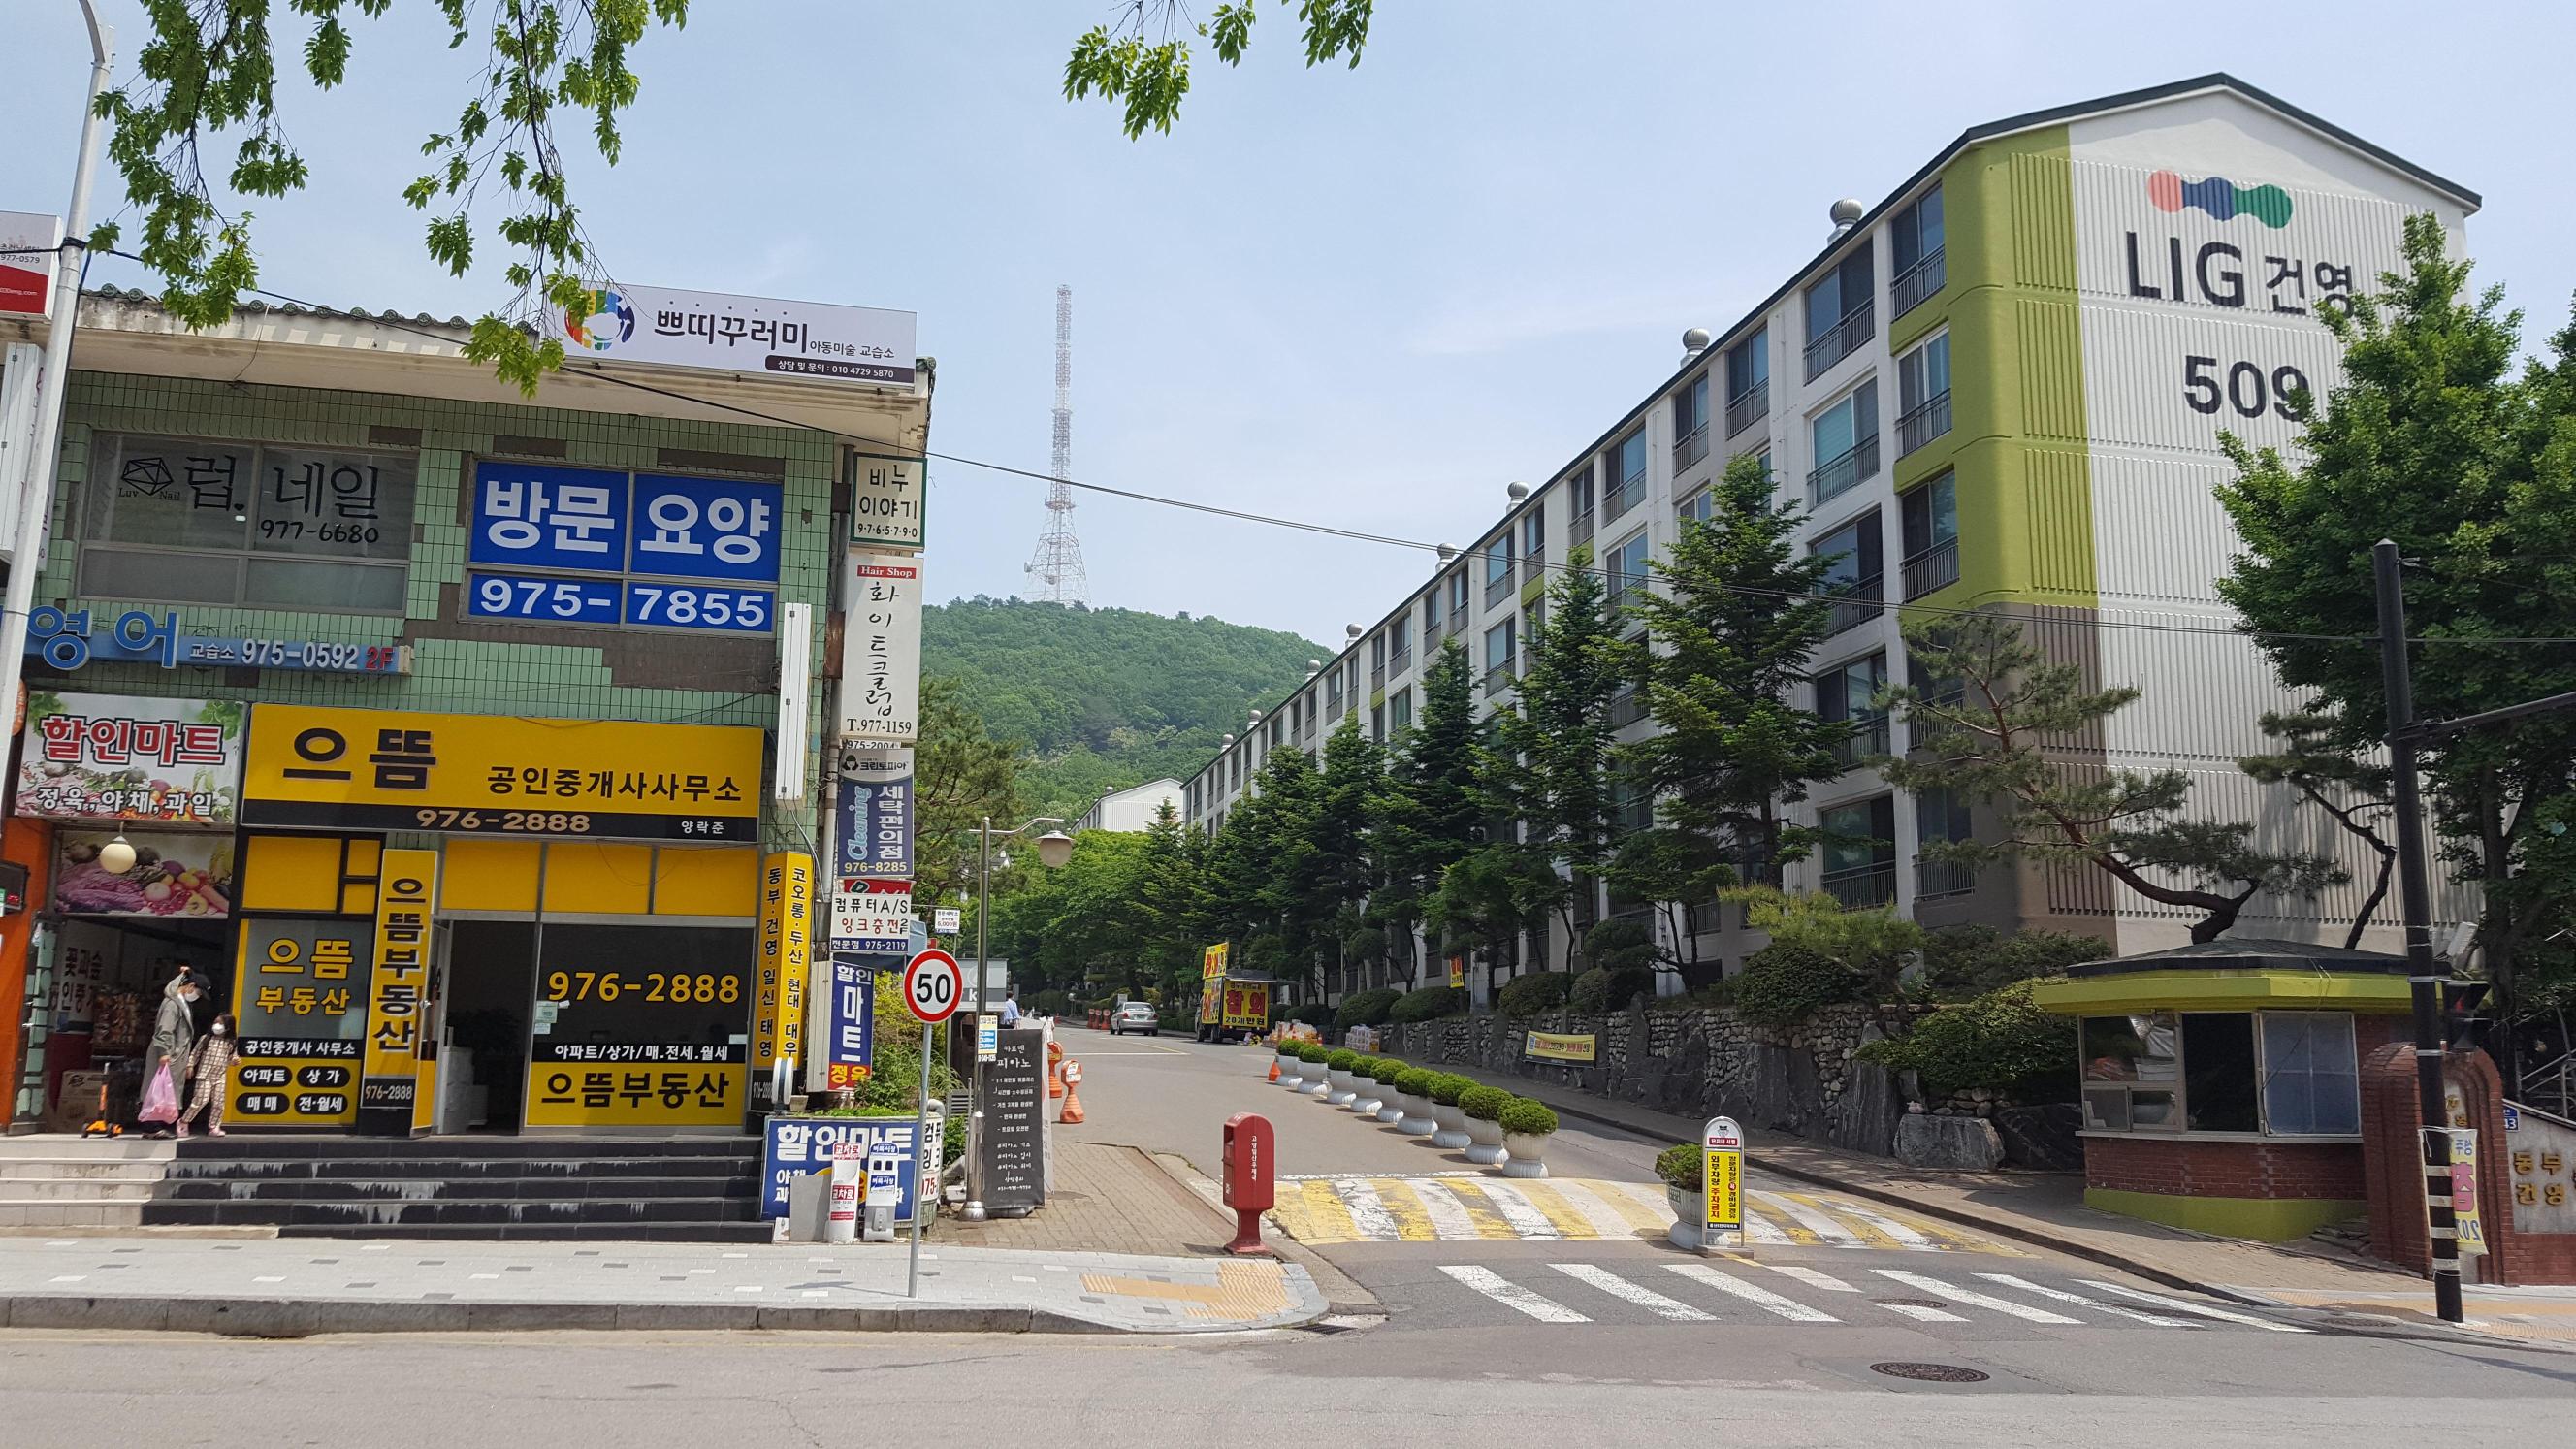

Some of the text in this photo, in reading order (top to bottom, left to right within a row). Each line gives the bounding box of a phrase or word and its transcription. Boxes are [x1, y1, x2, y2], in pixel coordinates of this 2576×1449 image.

[2126, 231, 2355, 320] LIG 건영
[654, 309, 808, 354] 쁘띠꾸러미
[810, 340, 894, 359] 아동미술 교습소
[778, 360, 795, 370] 상담
[797, 361, 806, 371] 및
[808, 363, 824, 373] 문의
[832, 365, 848, 374] 010
[850, 367, 871, 376] 4729
[873, 369, 894, 378] 5870
[2184, 355, 2312, 423] 509
[274, 462, 379, 520] 네일
[869, 465, 909, 492] 비누
[159, 490, 181, 501] Nail
[859, 496, 918, 520] 이야기
[260, 519, 379, 544] 977-6680
[484, 480, 770, 564] 방문 요양
[860, 565, 913, 578] Hair Shop
[27, 604, 180, 670] 영어
[189, 638, 396, 670] 교습소 975-0592 2F
[847, 718, 912, 734] T.977-1159
[40, 715, 227, 768] 할인마트
[282, 727, 436, 790] 으뜸
[859, 761, 907, 771] 크린토피아
[487, 766, 743, 802] 공인중개사사무소
[416, 809, 590, 832] 976-2888
[681, 820, 724, 835] 양락준
[847, 785, 872, 861] Cleaning
[878, 785, 905, 859] 세탁편의점
[844, 861, 907, 873] 976-8285
[841, 918, 899, 935] 잉크충전
[260, 938, 354, 980] 으뜸
[372, 877, 426, 1052] 으뜸부동산
[256, 985, 351, 1015] 부동산
[548, 971, 739, 1004] 976-2888
[916, 973, 950, 1004] 50
[836, 965, 871, 1062] 할인 마트
[244, 1040, 356, 1056] 공인중개사 사무소
[997, 1057, 1032, 1069] 피아노
[244, 1069, 340, 1084] 아파트 상가
[540, 1071, 730, 1109] 으뜸부동산
[247, 1095, 278, 1111] 매매
